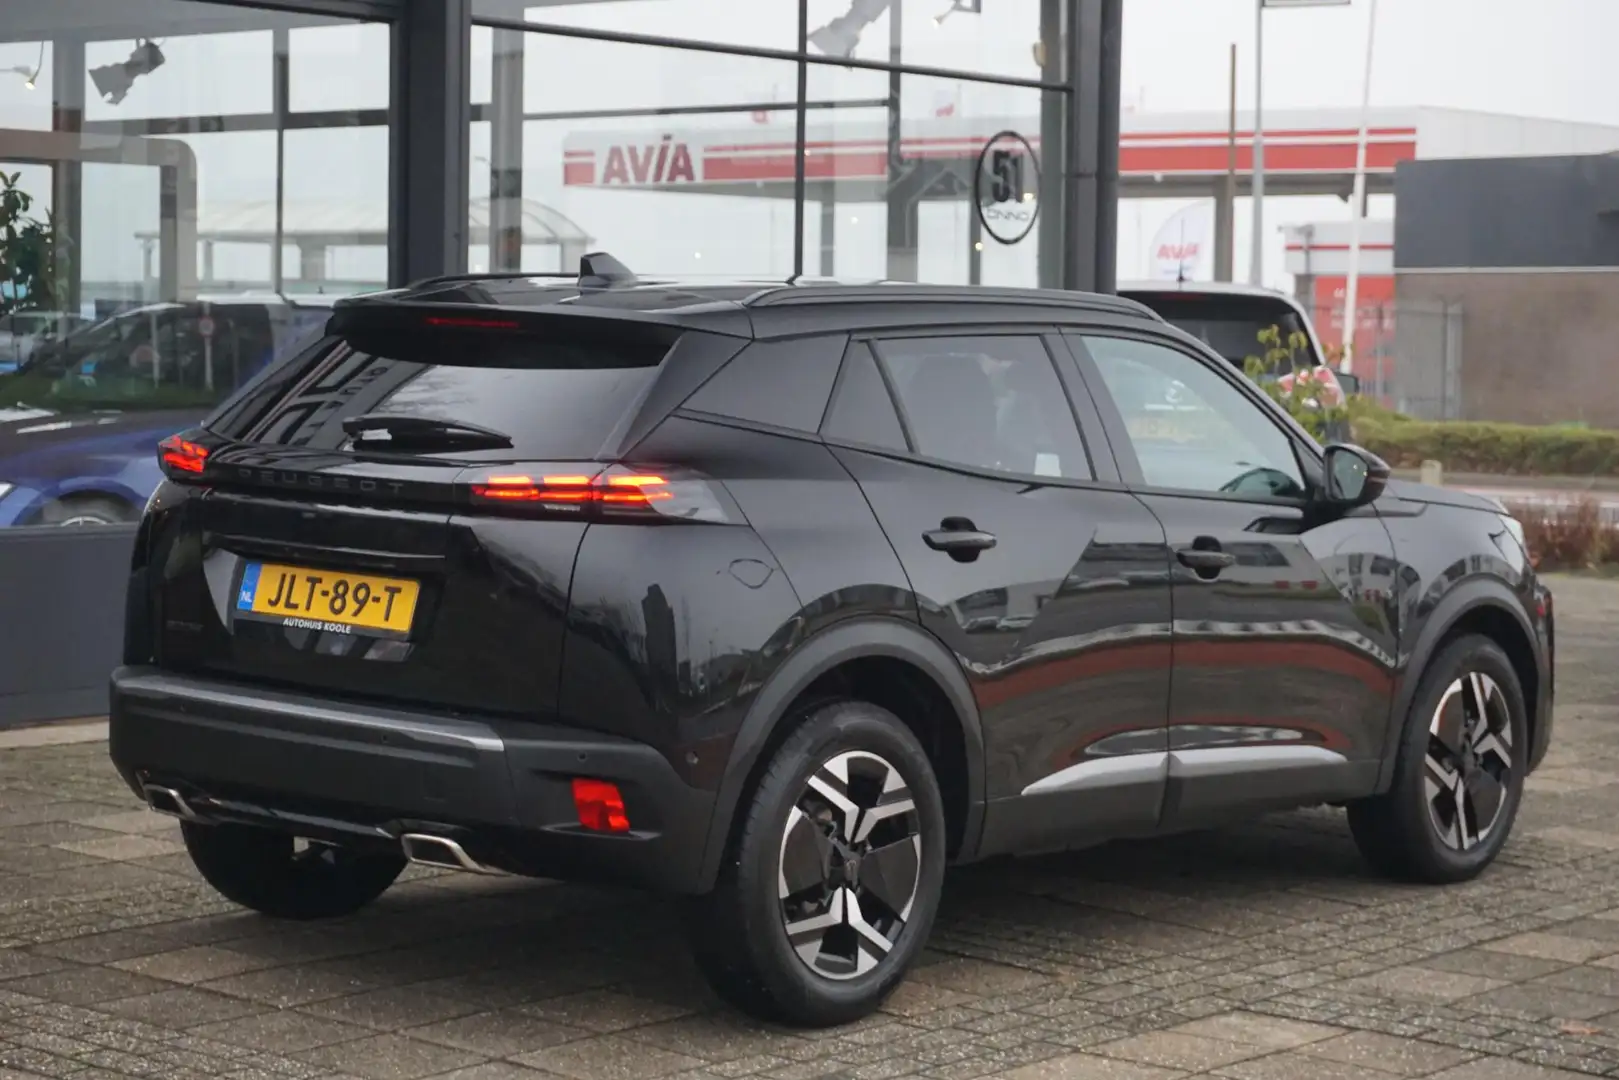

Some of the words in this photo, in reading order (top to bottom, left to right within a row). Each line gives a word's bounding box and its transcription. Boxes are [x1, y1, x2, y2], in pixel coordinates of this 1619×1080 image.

[238, 468, 404, 494] PEUGEOT
[240, 590, 253, 603] NL
[268, 572, 402, 622] JLT-89-T
[282, 616, 322, 630] AUTOHUIS
[323, 621, 352, 634] KOOLE
